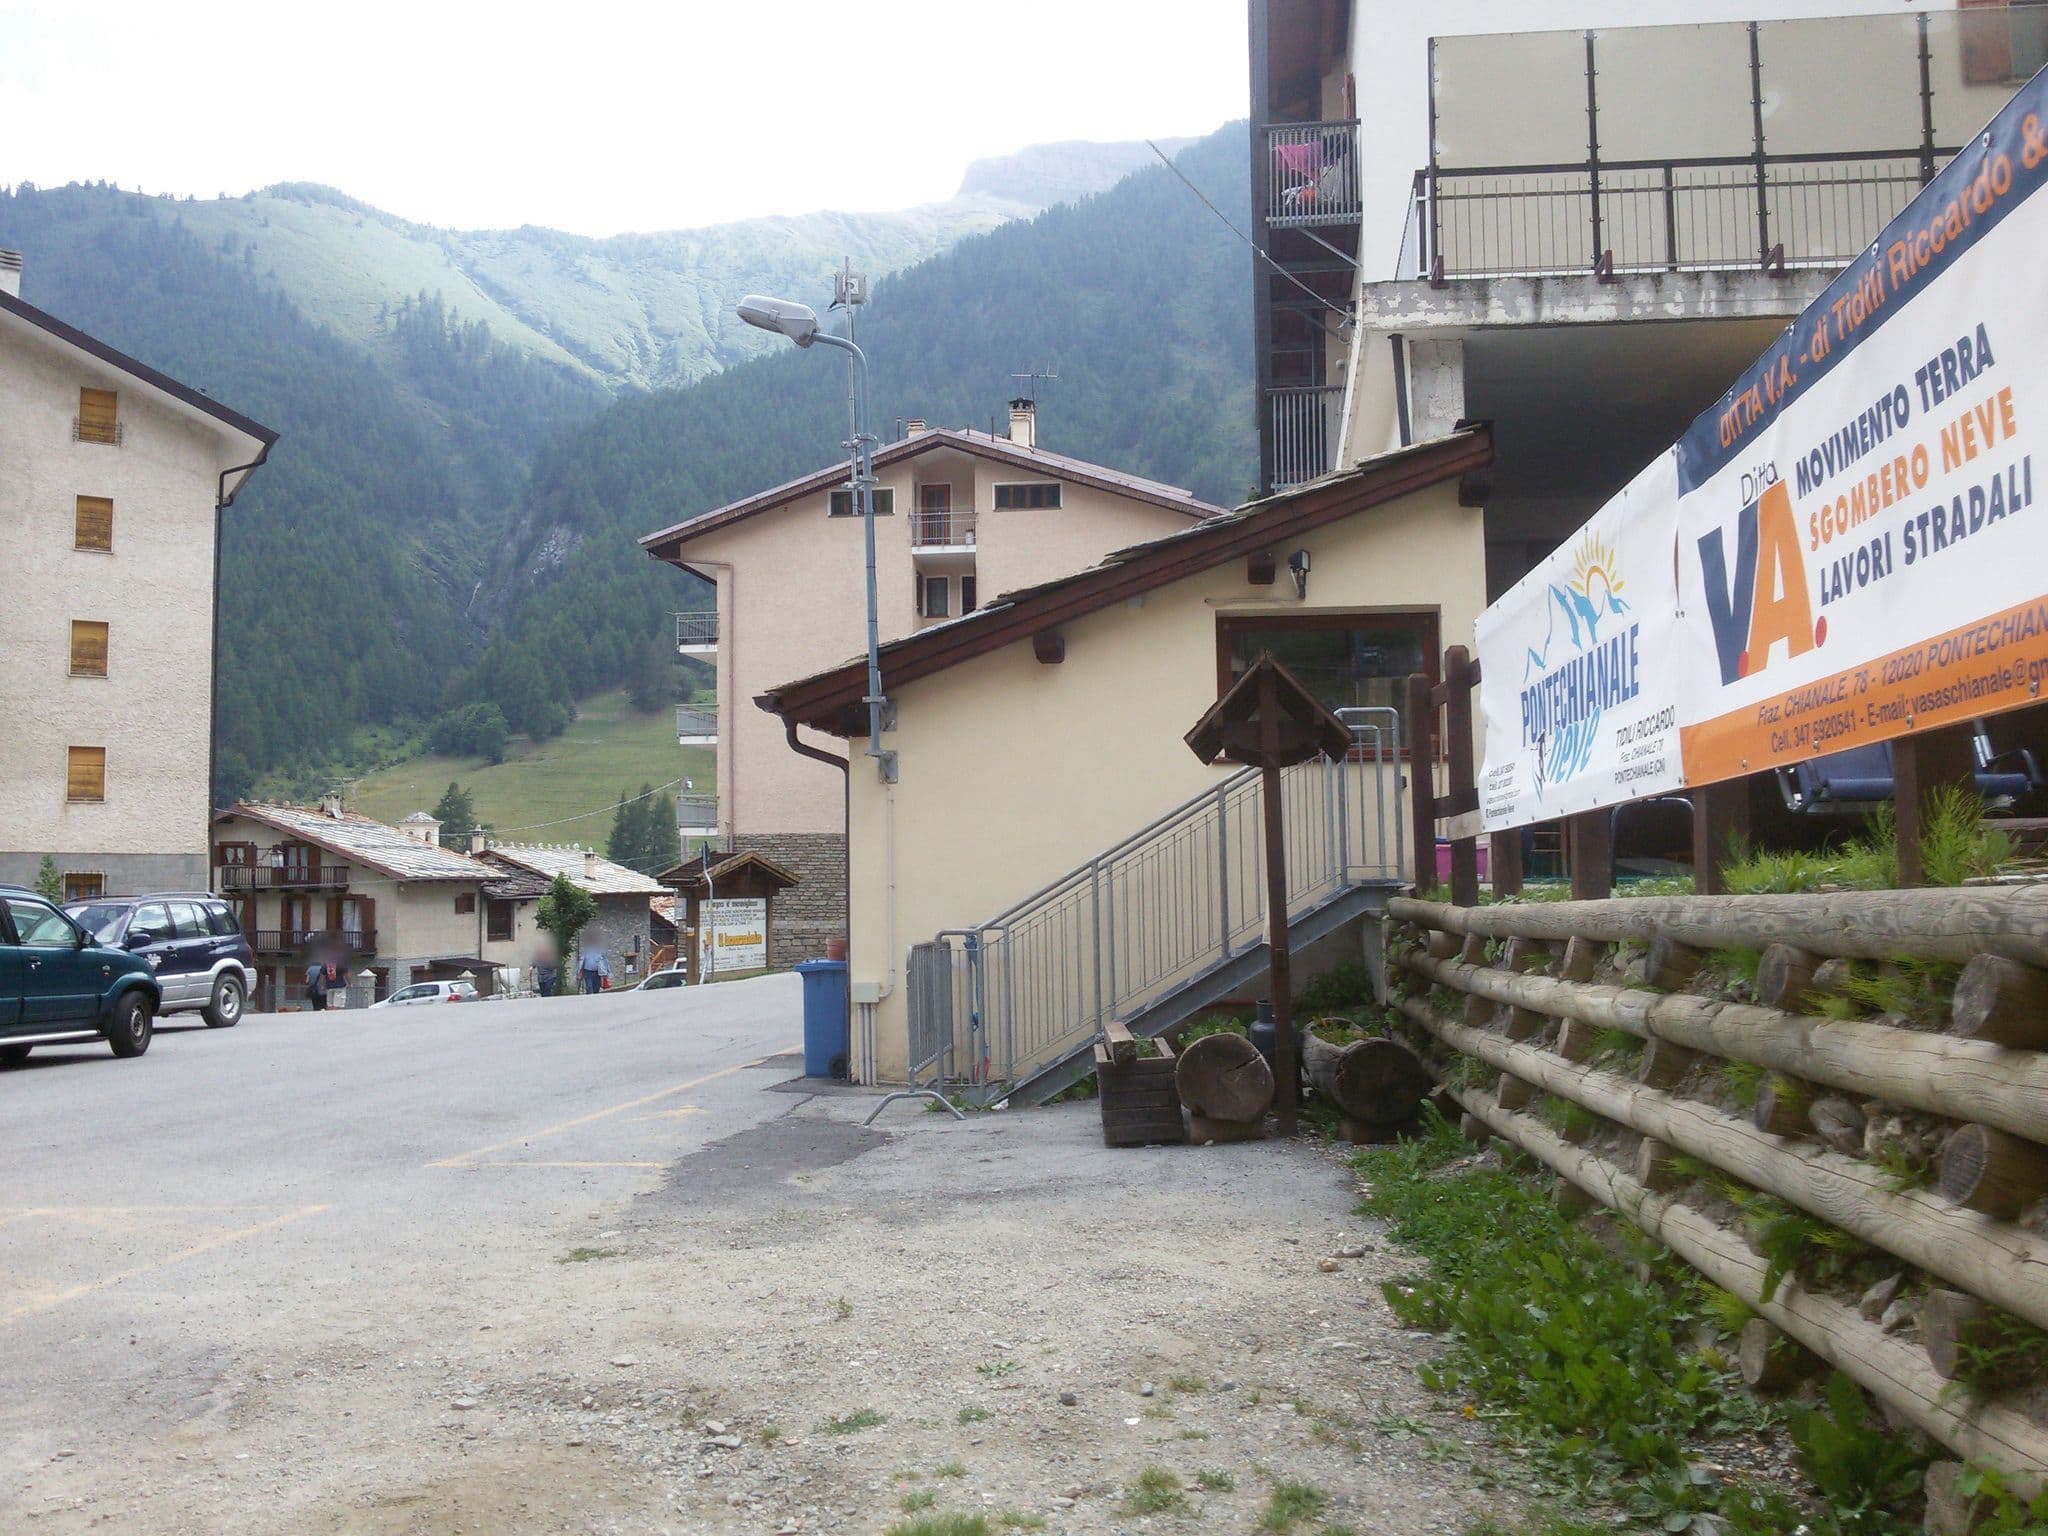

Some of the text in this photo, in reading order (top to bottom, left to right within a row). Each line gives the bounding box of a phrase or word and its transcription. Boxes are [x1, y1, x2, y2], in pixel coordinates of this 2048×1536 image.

[1719, 382, 1764, 449] DITTA
[1811, 314, 1831, 364] di
[1887, 154, 2013, 291] Riccardo
[1796, 322, 1995, 500] MOVIMENTO TERRA
[1741, 460, 1778, 507] Ditta
[1809, 386, 2017, 552] SGOMBERO NEVE
[1820, 454, 2032, 607] LAVORI STRADALI
[1520, 623, 1639, 748] PONTECHIANALE
[1881, 651, 1923, 687] 12020
[1547, 705, 1600, 784] neve
[1636, 705, 1675, 741] RICCARDO
[1793, 723, 1810, 746] 347
